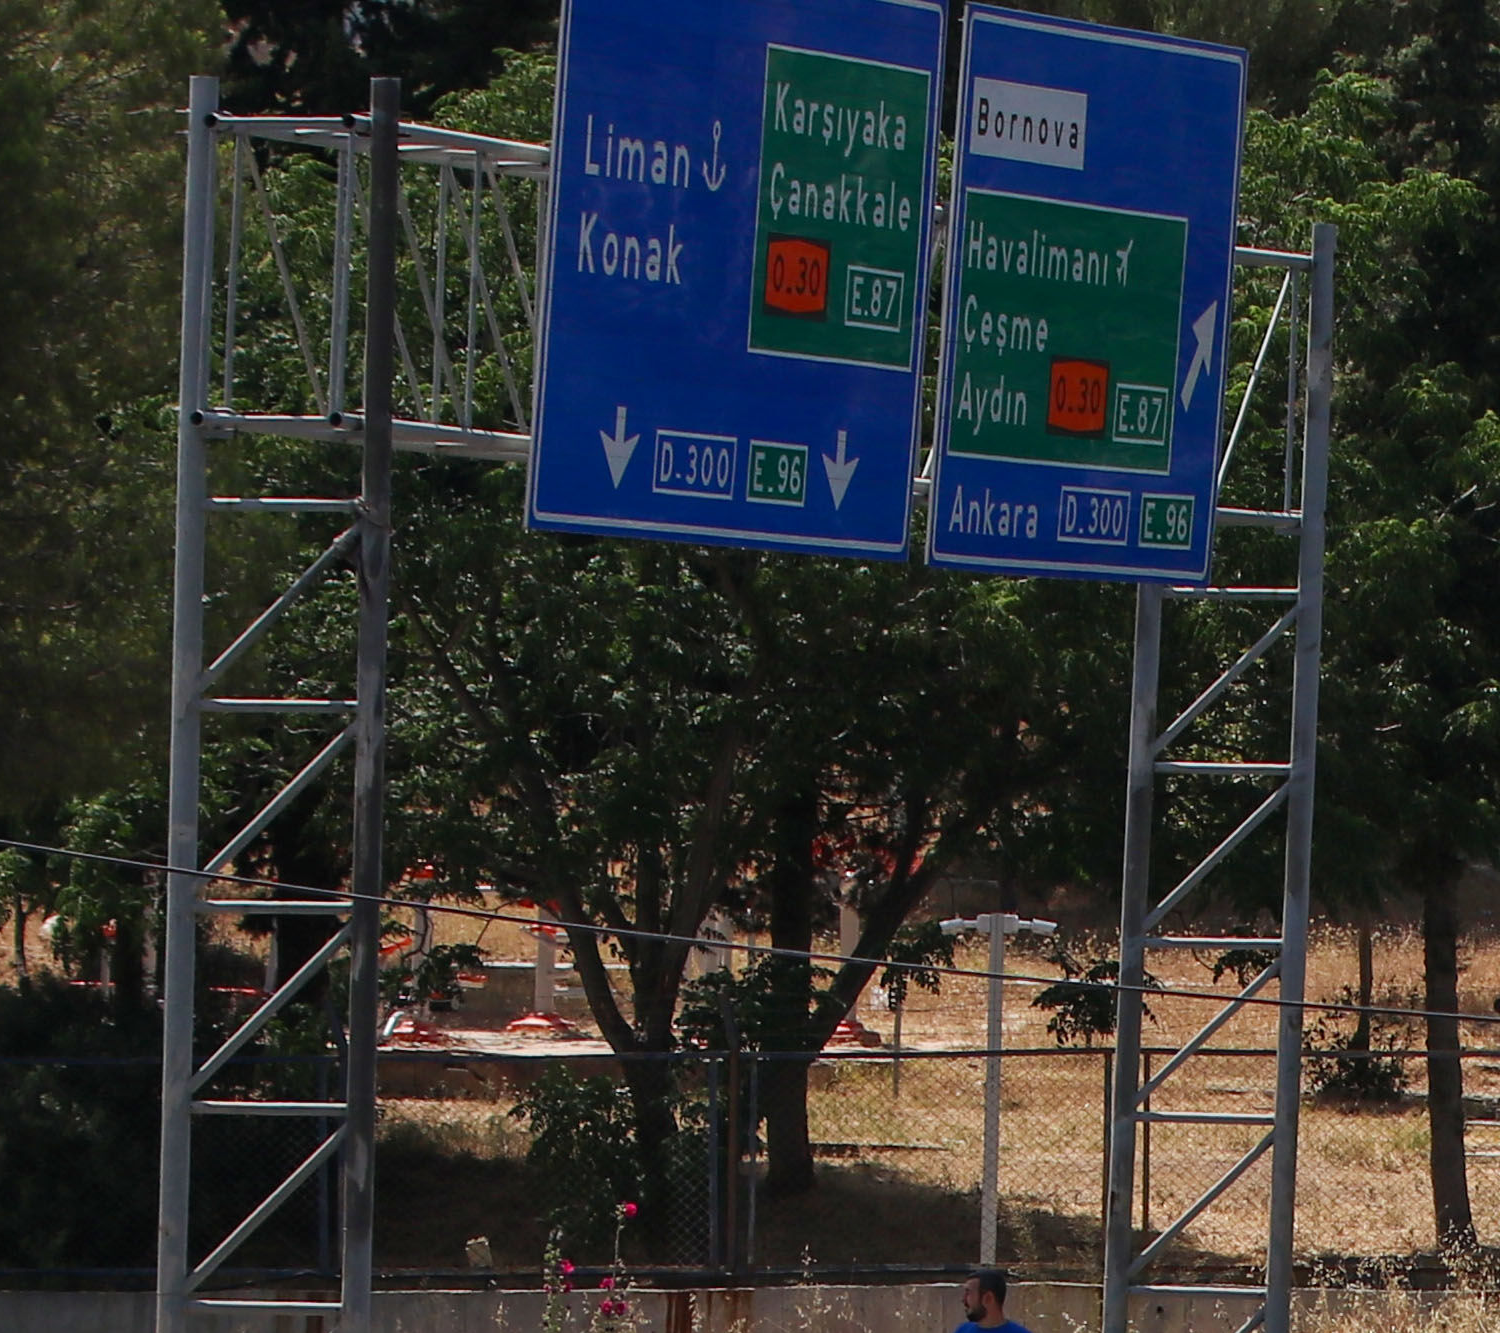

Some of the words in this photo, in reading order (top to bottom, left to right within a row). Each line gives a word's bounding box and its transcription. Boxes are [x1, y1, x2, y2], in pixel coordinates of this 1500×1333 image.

[773, 81, 907, 157] Karşıyaka
[976, 96, 1080, 153] Bornova
[583, 113, 691, 191] Liman
[769, 161, 911, 233] Çanakkale
[576, 211, 684, 287] Konak
[967, 220, 1112, 288] Havalimanı
[851, 275, 898, 320] E.87
[963, 296, 1050, 355] Çeşme
[957, 372, 1029, 436] Aydın
[1118, 393, 1163, 435] E.87
[659, 438, 730, 491] D.300
[753, 449, 802, 497] E.96
[949, 484, 1039, 539] Ankara
[1064, 494, 1123, 539] D.300
[1142, 500, 1189, 543] E.96
